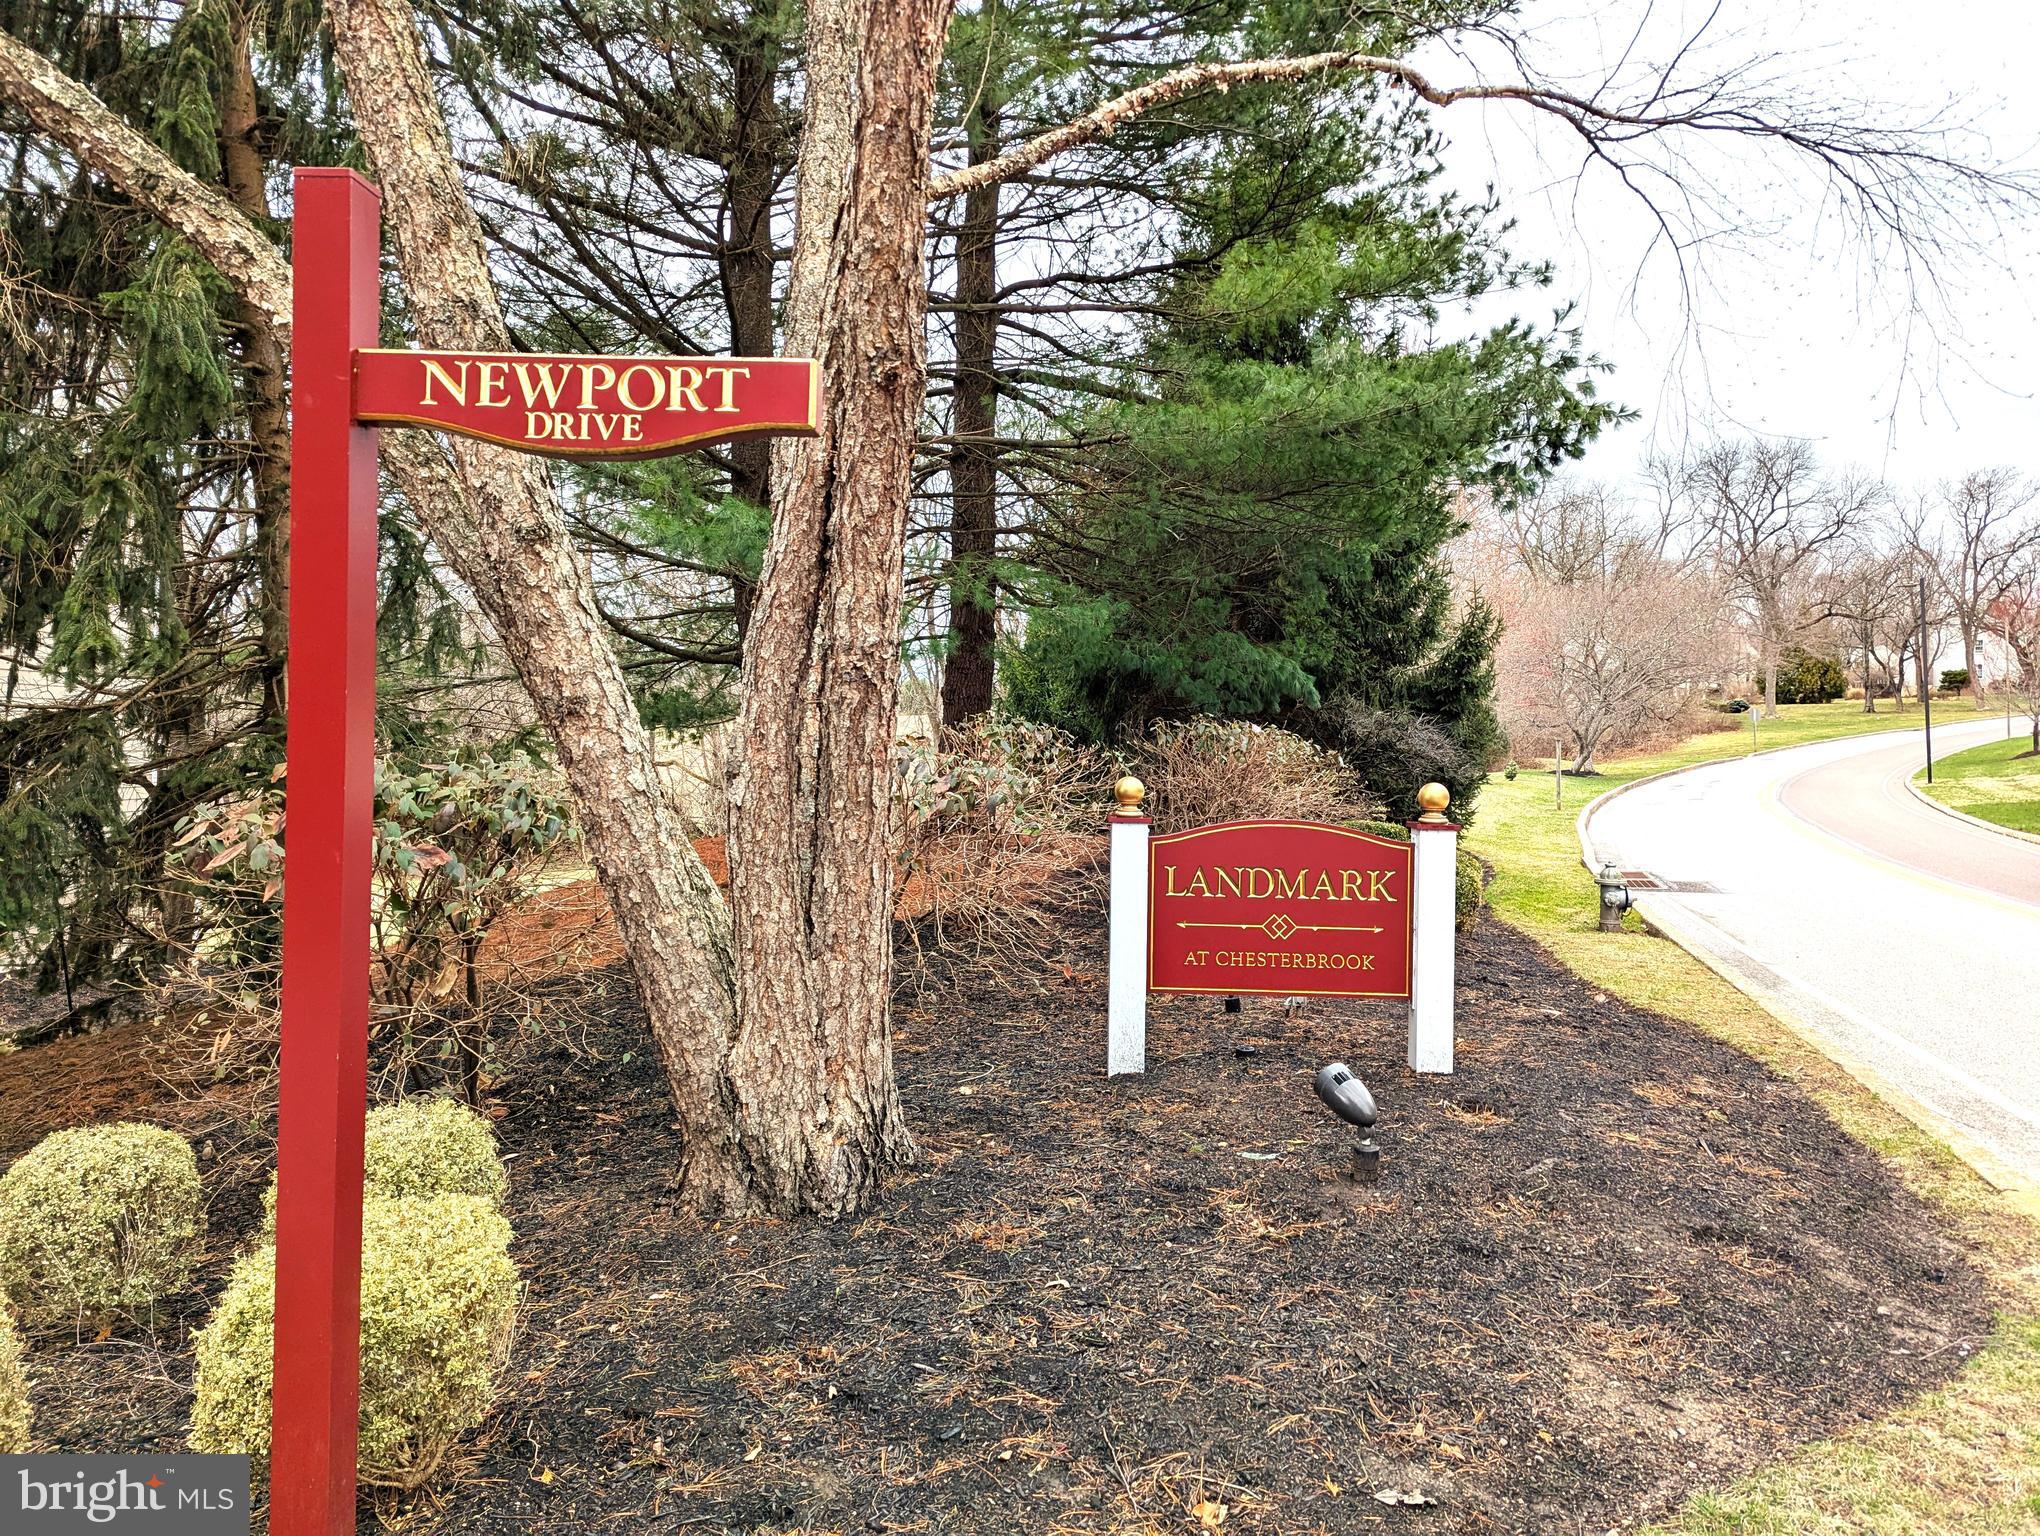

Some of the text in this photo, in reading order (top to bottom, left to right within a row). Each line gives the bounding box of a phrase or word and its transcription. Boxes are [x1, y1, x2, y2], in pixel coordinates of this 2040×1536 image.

[419, 359, 750, 413] NEWPORT
[524, 411, 644, 441] DRIVE
[1164, 865, 1398, 902] LANDMARK
[1184, 951, 1376, 970] AT CHESTERBROOK
